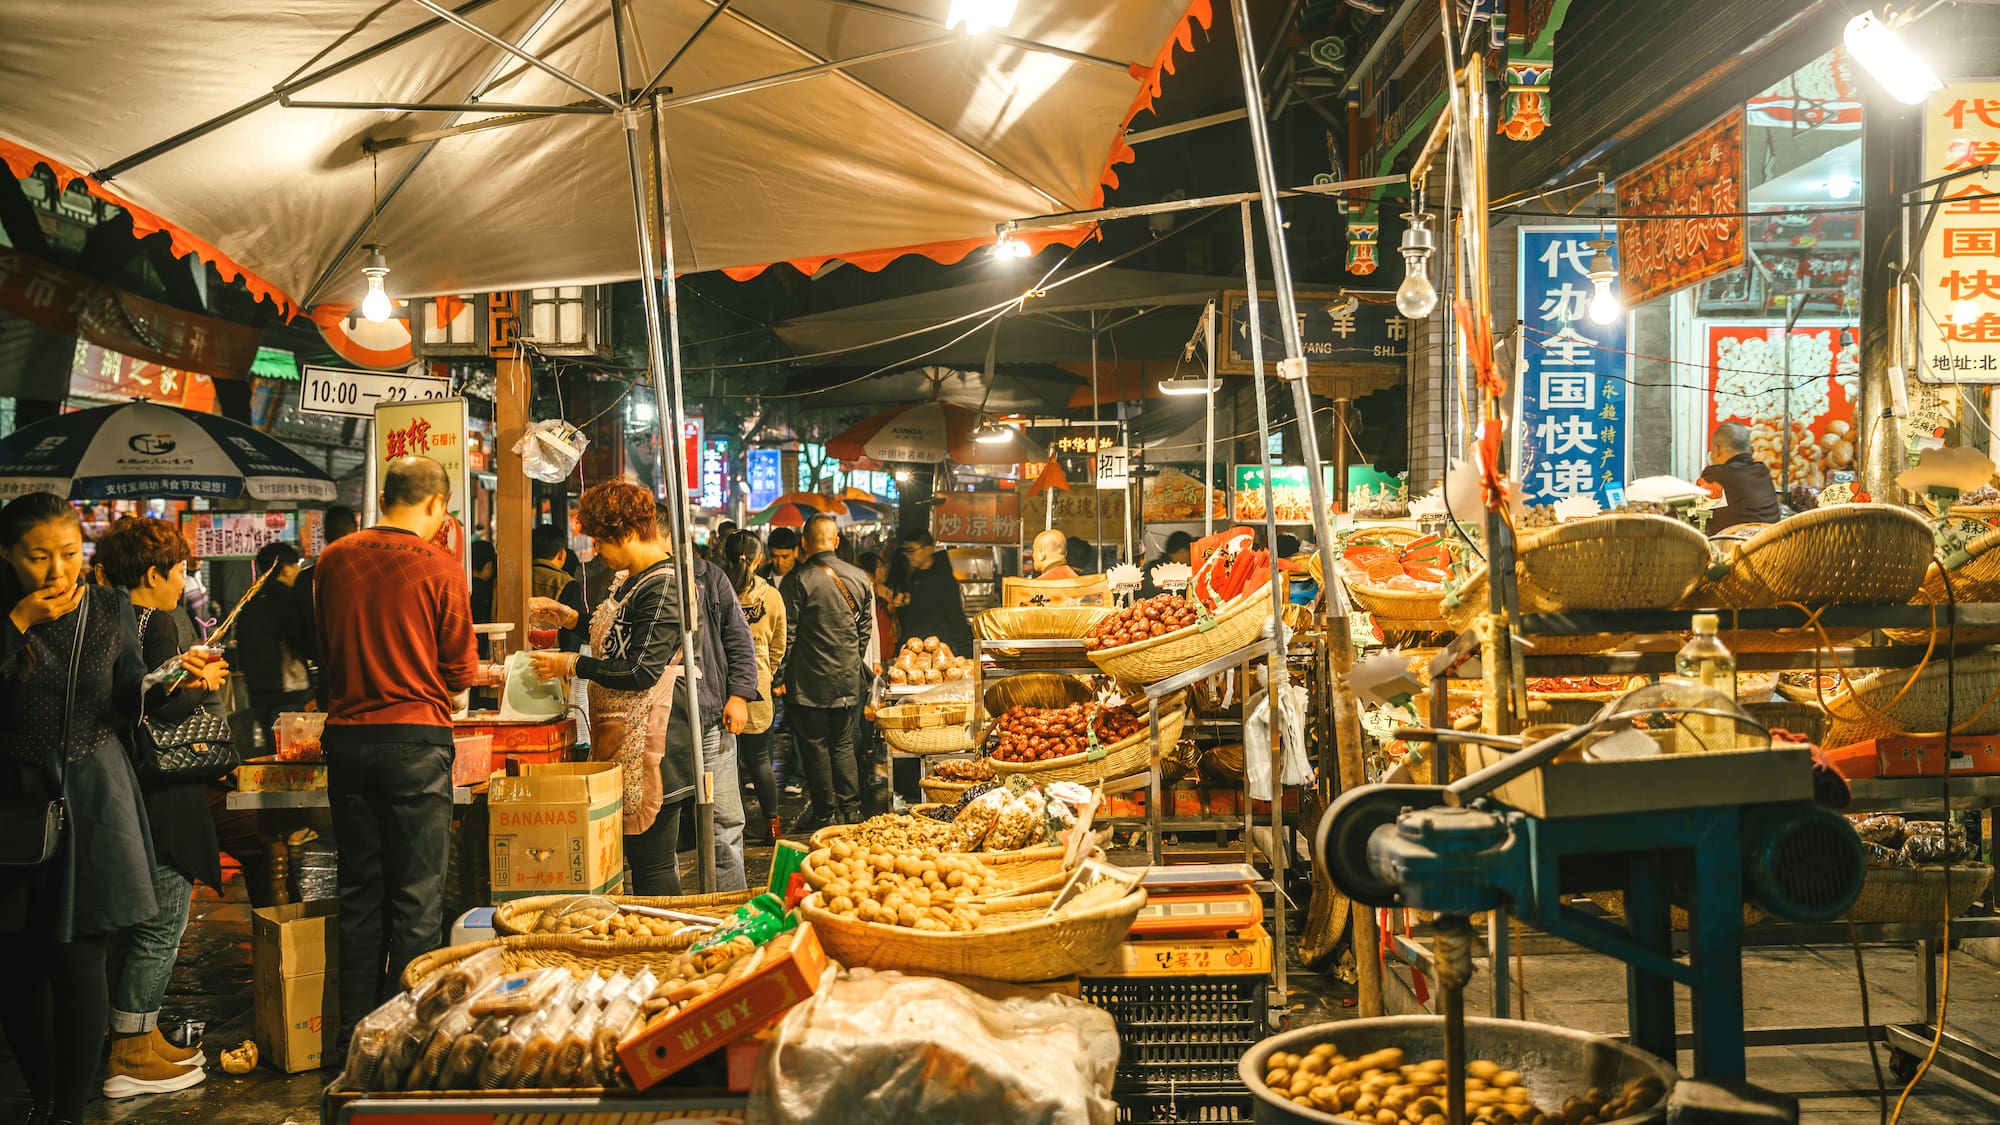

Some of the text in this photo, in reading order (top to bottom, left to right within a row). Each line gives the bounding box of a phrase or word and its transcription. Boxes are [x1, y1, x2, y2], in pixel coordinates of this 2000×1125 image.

[1374, 345, 1396, 357] SHI
[1536, 239, 1600, 500] 代办全国快递
[311, 379, 358, 405] 10:00
[385, 416, 431, 462] 鲜榨
[1099, 453, 1127, 479] 招工
[938, 512, 1016, 538] 炒凉粉
[500, 809, 578, 827] BANANAS
[572, 839, 581, 852] 3
[573, 855, 581, 867] 4
[573, 871, 582, 882] 5
[677, 997, 752, 1051] 天然干果
